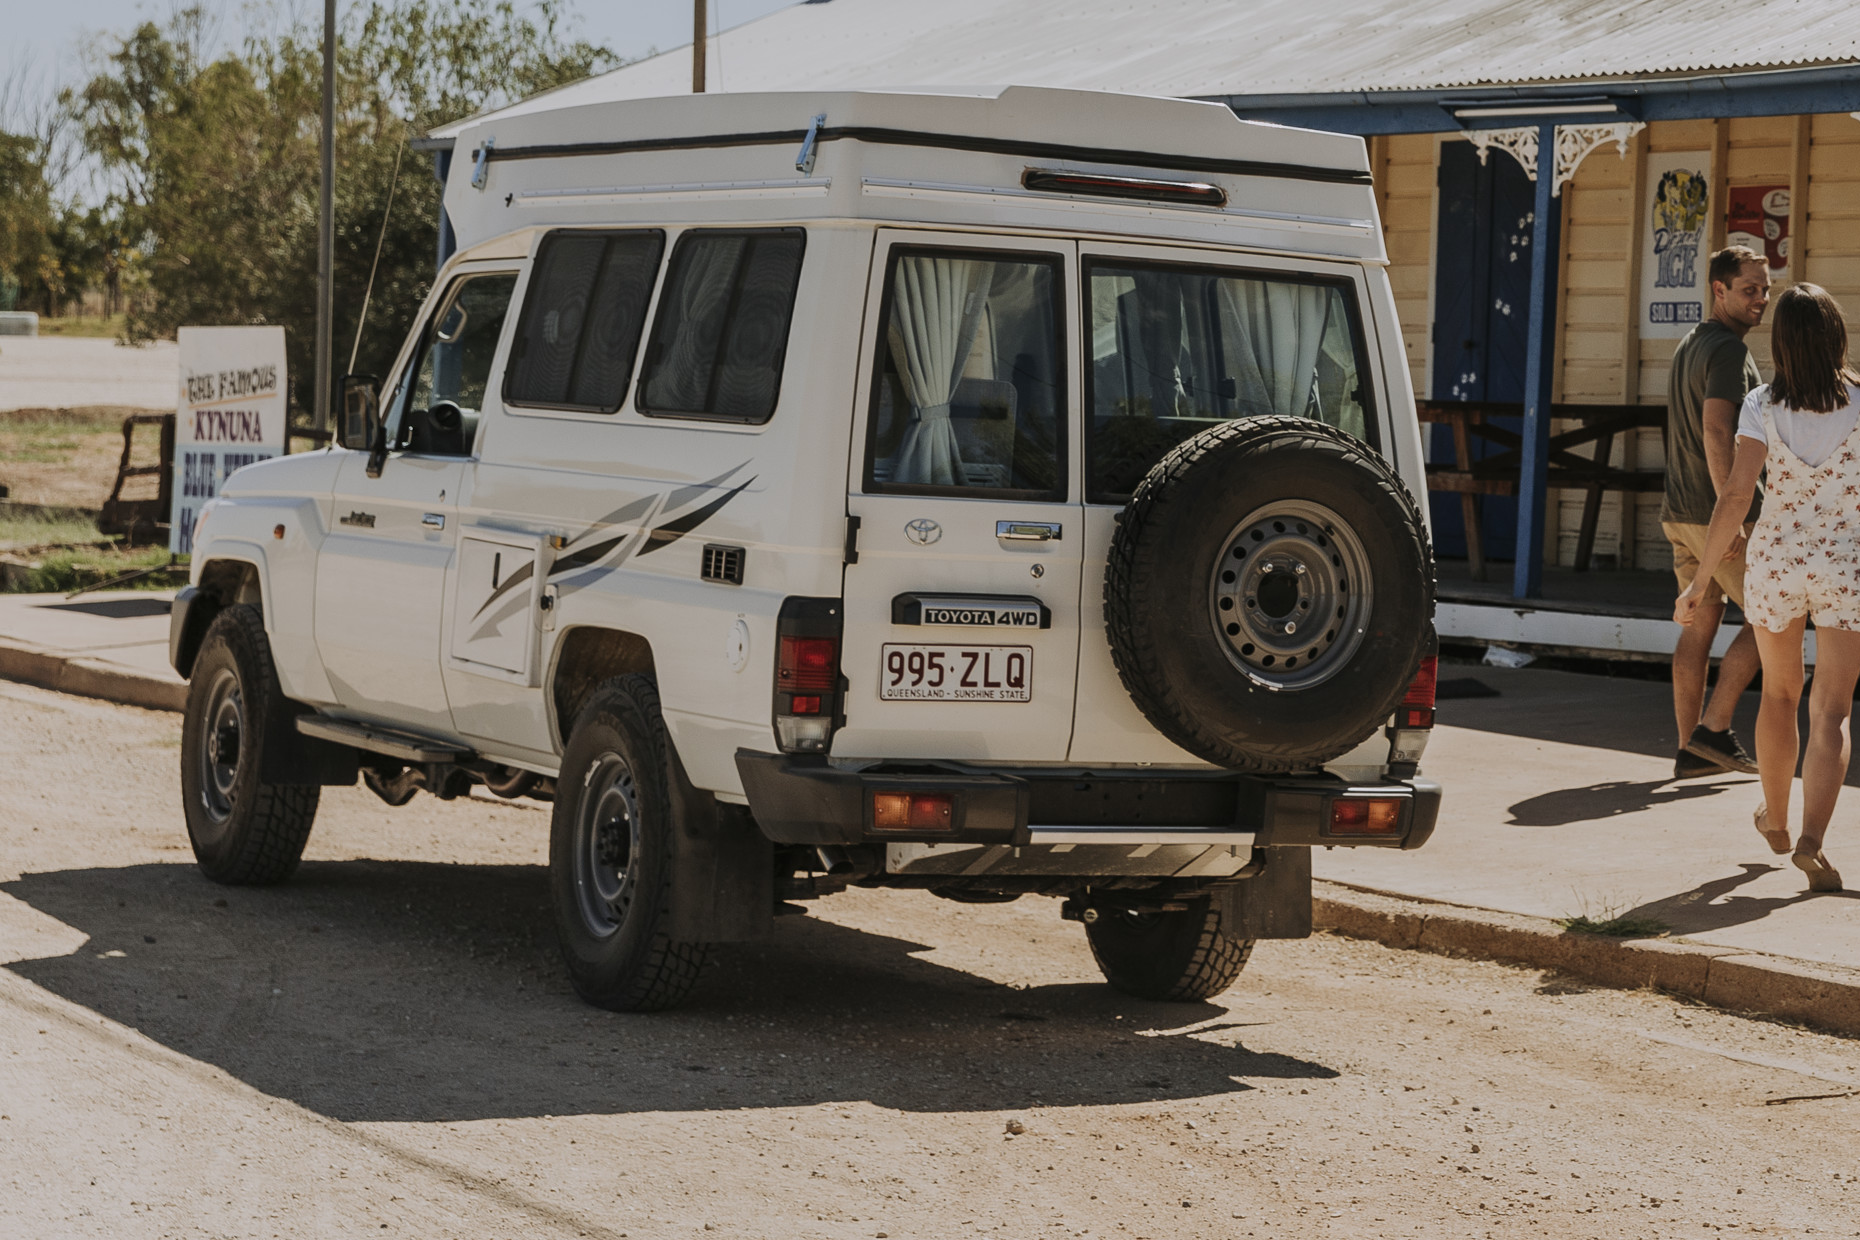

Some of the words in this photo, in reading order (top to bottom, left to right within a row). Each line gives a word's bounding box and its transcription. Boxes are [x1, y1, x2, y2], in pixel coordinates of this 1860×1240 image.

[1654, 246, 1698, 288] ICE
[1651, 304, 1674, 322] SOLD
[1676, 304, 1700, 322] HERE
[194, 410, 263, 443] KYNUNA
[928, 610, 992, 624] TOYOTA
[997, 611, 1038, 626] 4WD
[887, 651, 945, 688] 995
[959, 651, 1025, 689] ZLQ
[887, 689, 945, 699] QUEENSLAND
[954, 689, 995, 699] SUNSHINE
[999, 689, 1025, 700] STATE
